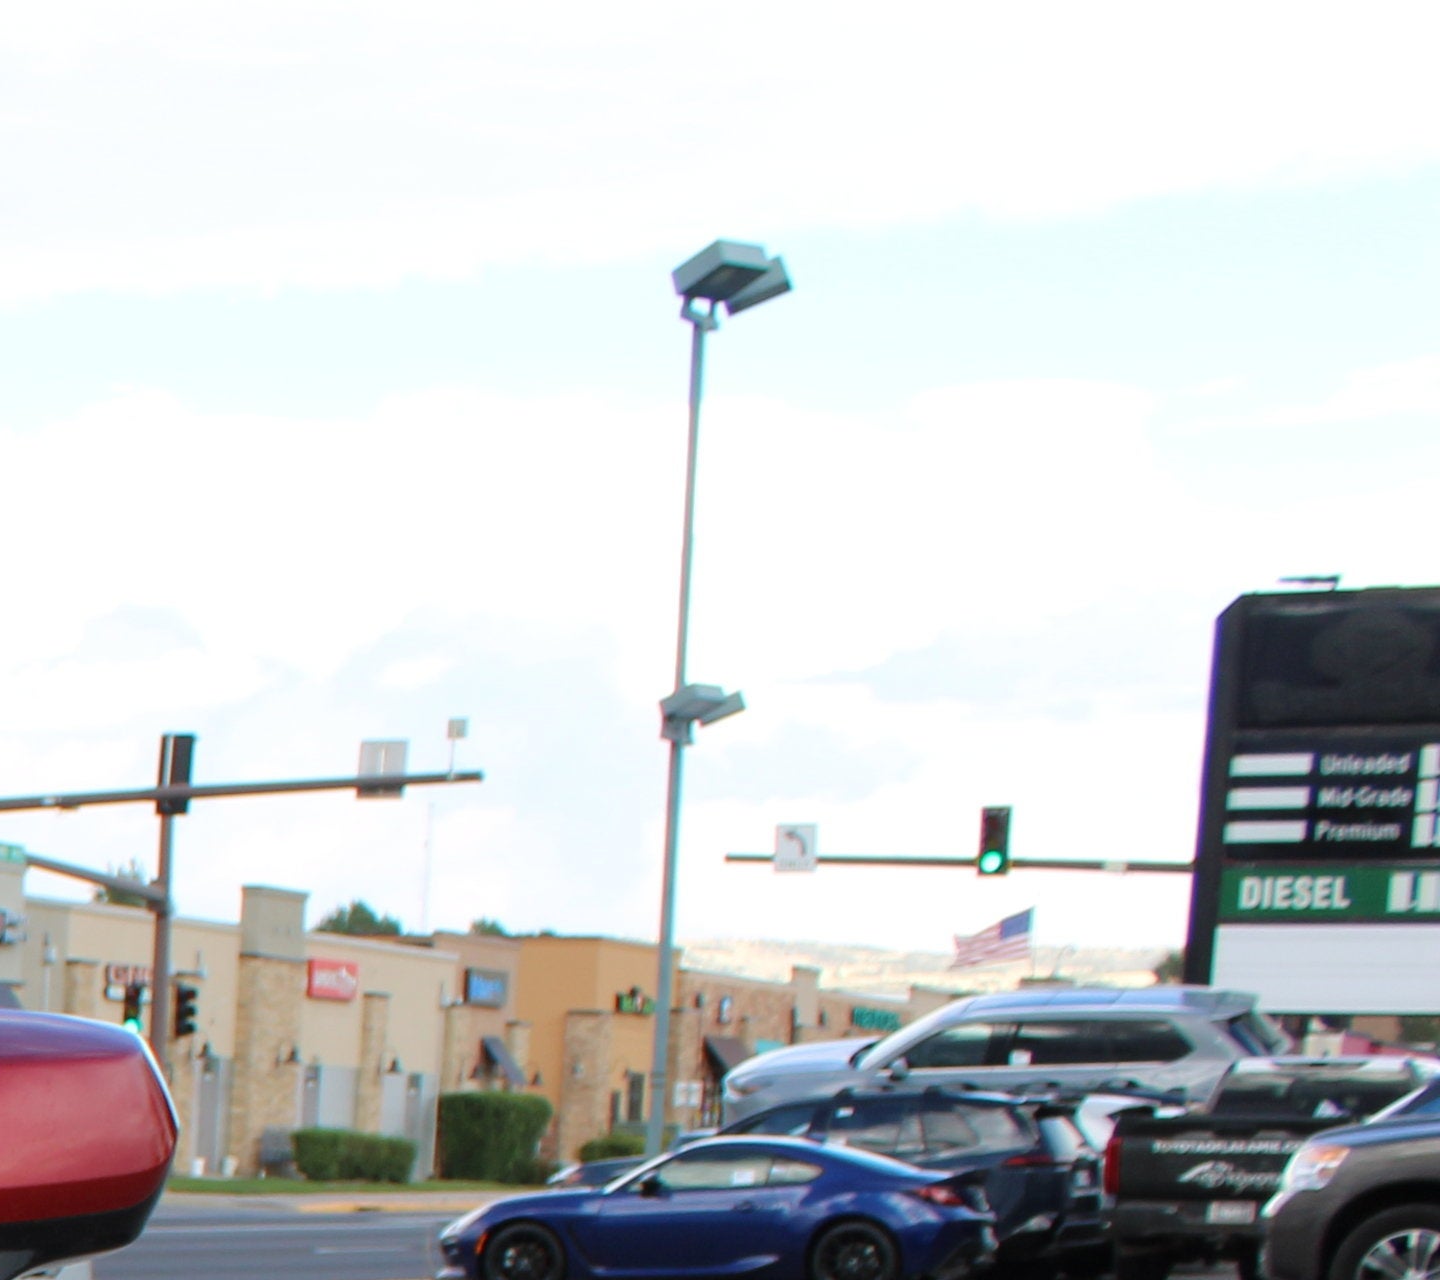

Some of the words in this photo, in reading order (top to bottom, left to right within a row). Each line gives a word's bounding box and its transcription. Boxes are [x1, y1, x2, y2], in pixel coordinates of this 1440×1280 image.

[1319, 753, 1411, 775] Unleaded
[1316, 786, 1413, 808] Mid-Grade
[1313, 819, 1401, 842] Premium
[1237, 876, 1351, 910] DIESEL
